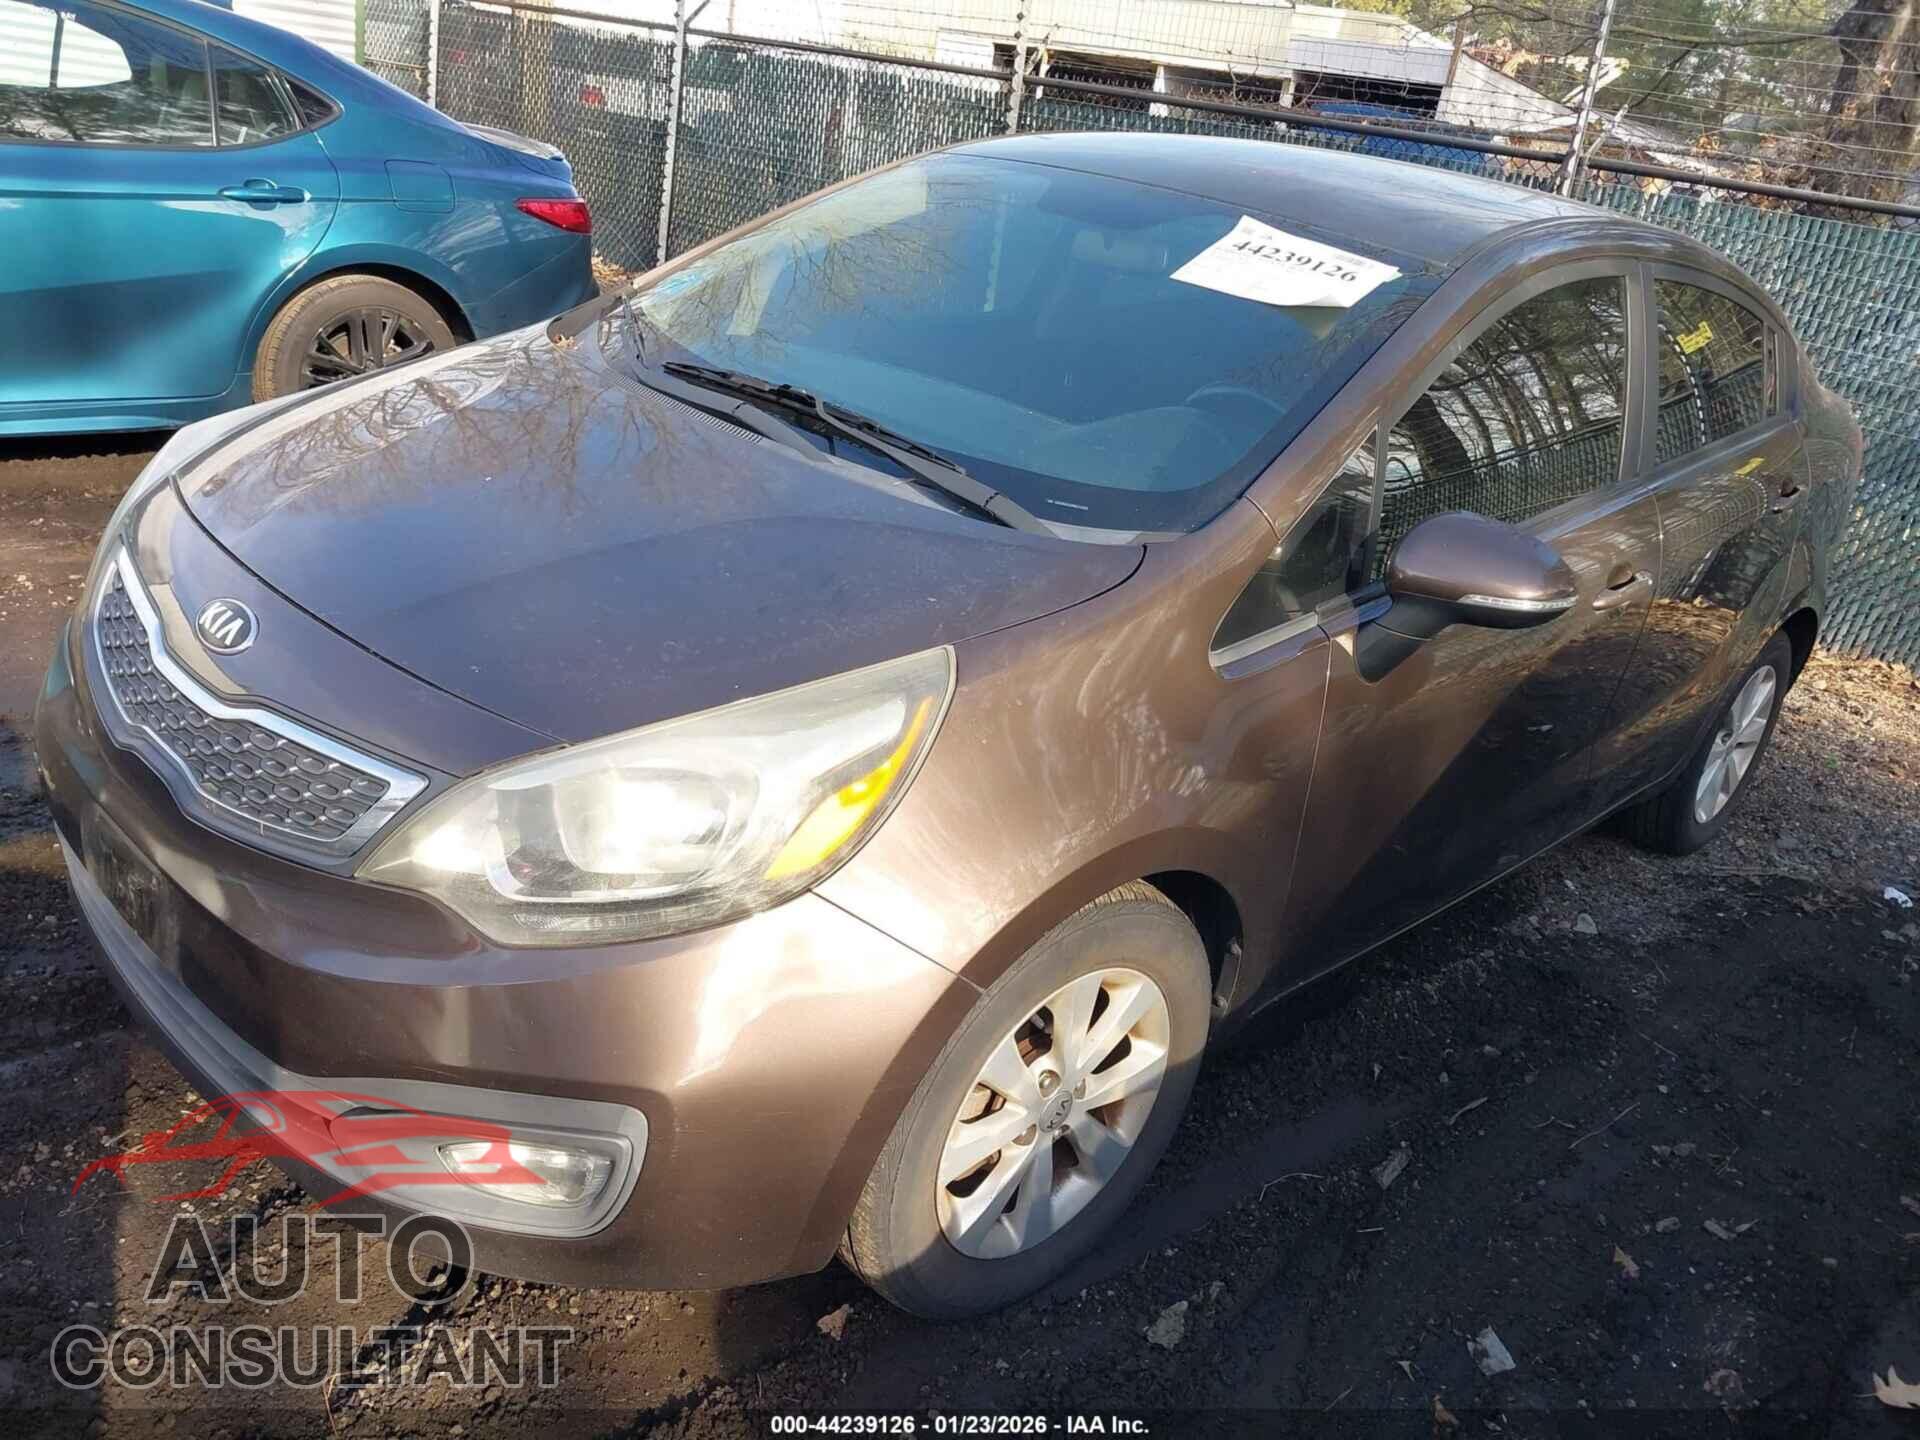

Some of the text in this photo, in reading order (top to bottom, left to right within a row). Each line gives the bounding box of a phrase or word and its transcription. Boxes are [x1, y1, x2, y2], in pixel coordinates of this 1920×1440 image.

[1232, 240, 1356, 282] 44239126
[198, 601, 244, 646] KIA
[1047, 1099, 1070, 1129] KIA
